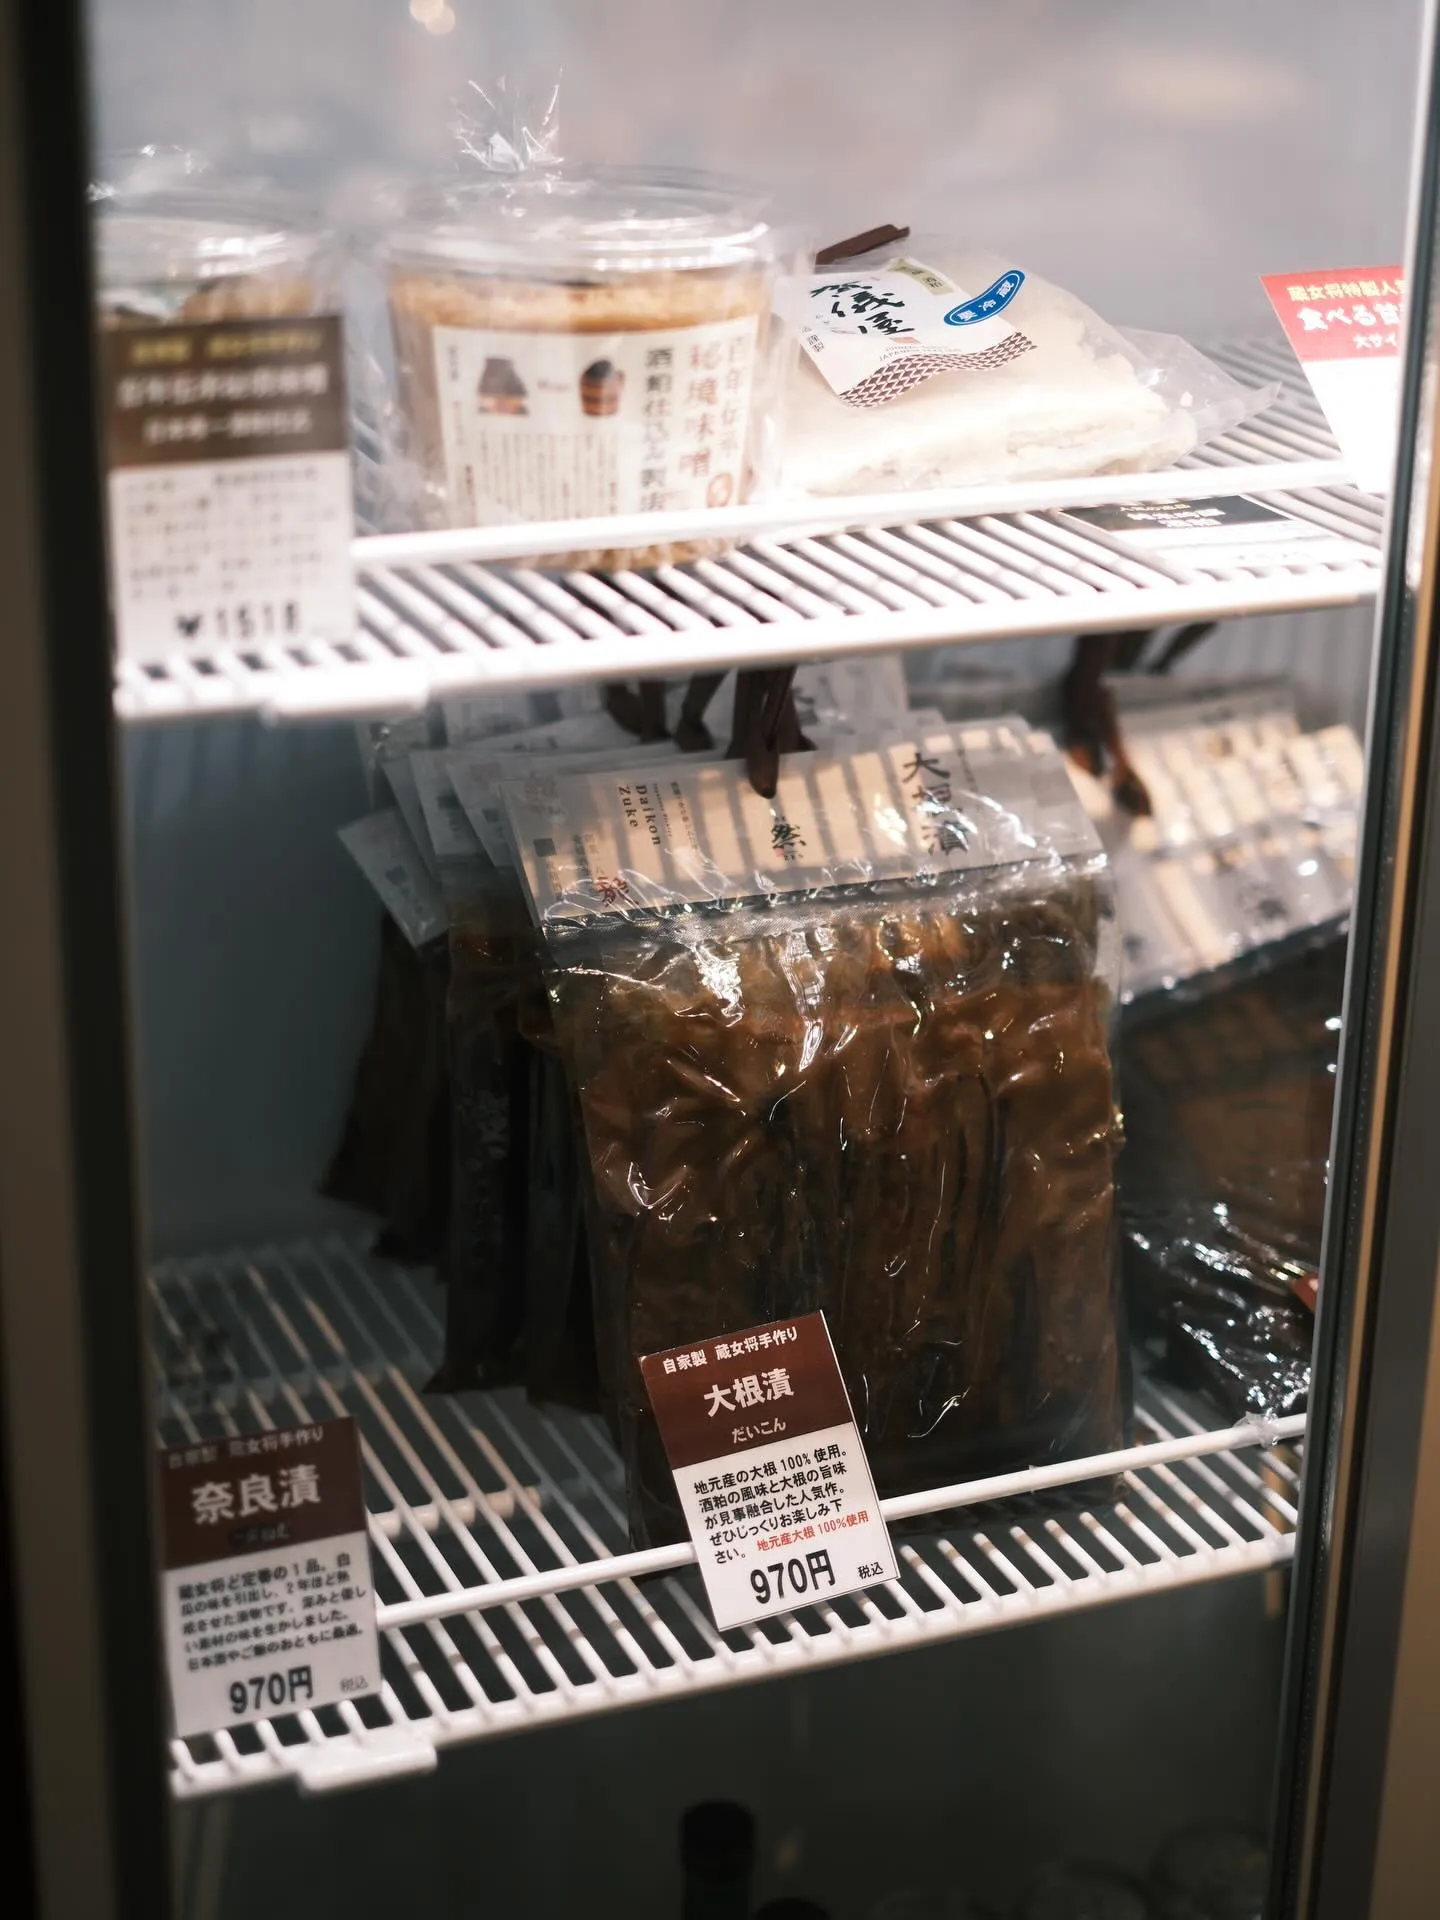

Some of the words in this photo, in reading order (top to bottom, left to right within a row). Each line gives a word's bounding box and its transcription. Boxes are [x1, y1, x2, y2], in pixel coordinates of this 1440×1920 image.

[1297, 302, 1404, 331] 食べる甘
[618, 785, 638, 828] Zuke
[635, 783, 661, 845] Daikon
[662, 1349, 708, 1375] 自家製
[714, 1326, 798, 1361] 蔵女将手作り
[703, 1368, 795, 1418] 大根漬
[731, 1418, 786, 1444] だいこん
[192, 1464, 320, 1525] 奈良漬
[698, 1460, 848, 1514] 酒粕の風味と大根の旨味
[704, 1482, 846, 1531] が見事融合した人気作。
[709, 1498, 843, 1547] ぜひじっくりお楽しみ下
[714, 1547, 747, 1565] さい。
[750, 1549, 837, 1606] 970円
[858, 1562, 884, 1581] 税込
[229, 1665, 314, 1716] 970円
